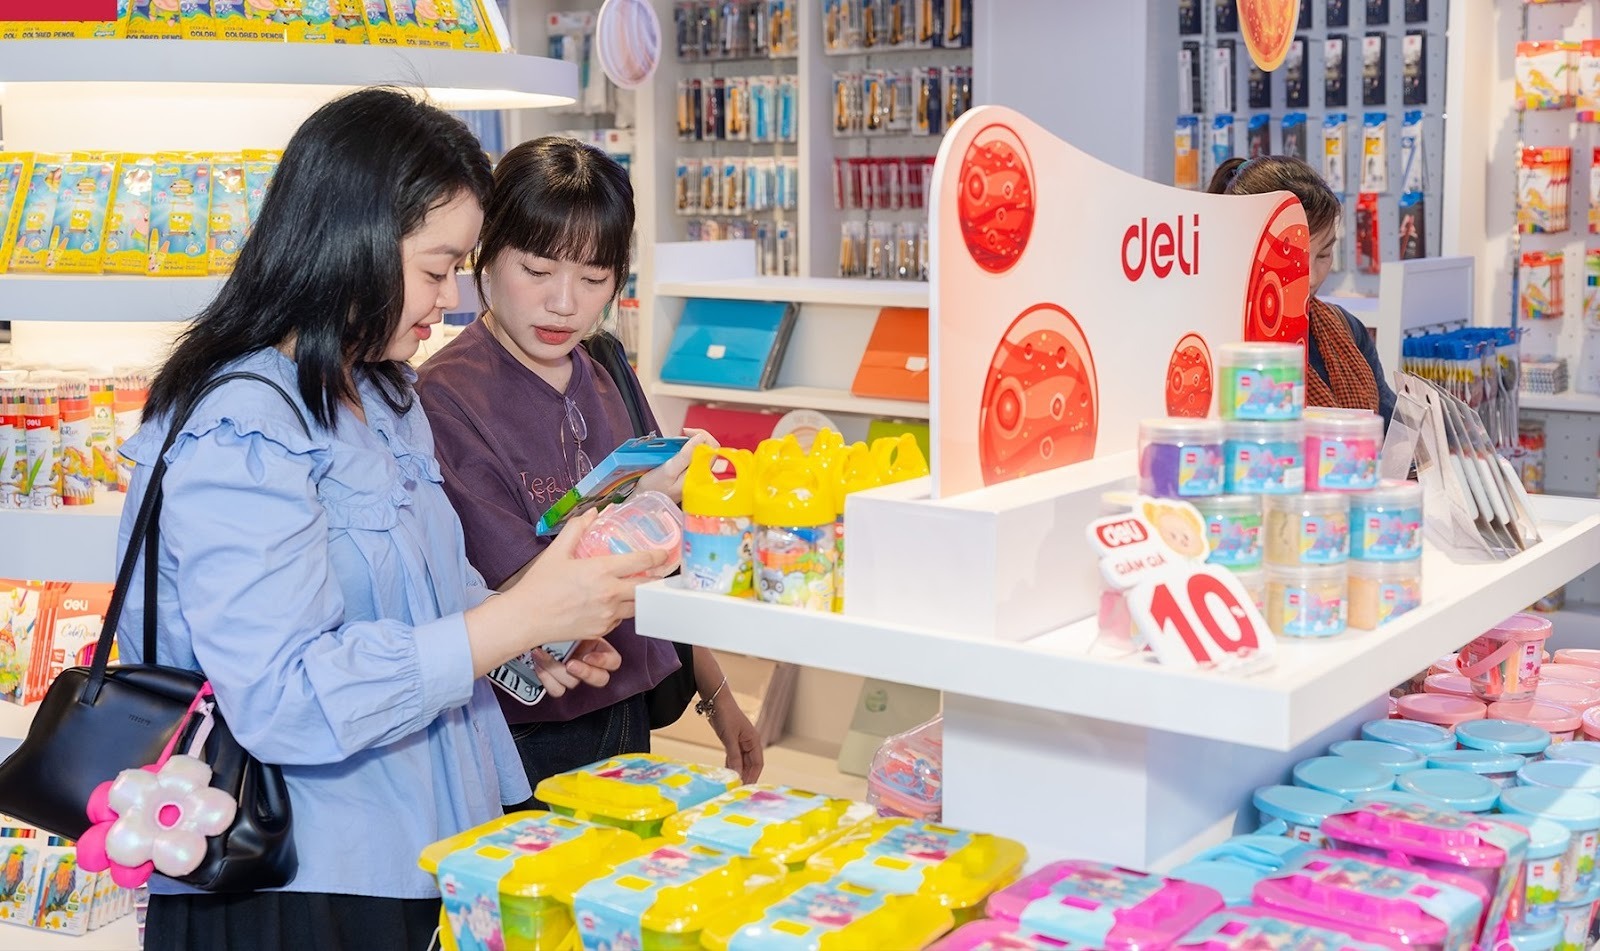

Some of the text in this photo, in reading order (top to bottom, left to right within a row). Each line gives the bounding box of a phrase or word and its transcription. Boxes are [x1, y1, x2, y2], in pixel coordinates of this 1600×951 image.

[1121, 213, 1199, 282] deli
[1103, 520, 1143, 545] deli
[63, 599, 88, 611] deli
